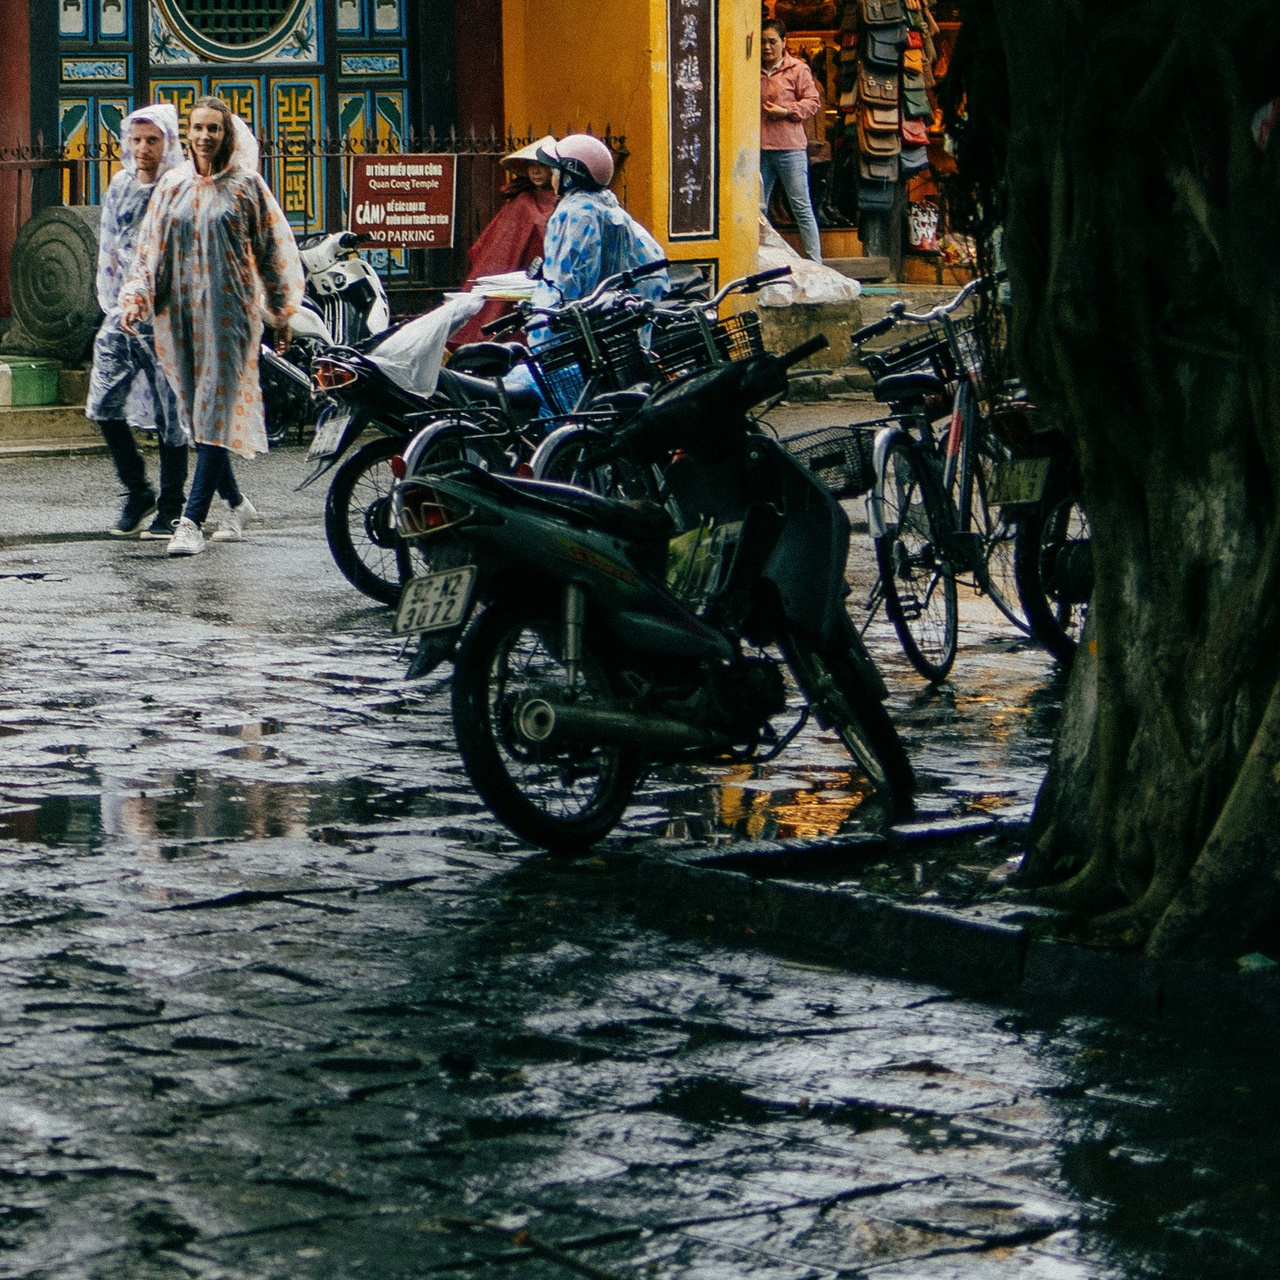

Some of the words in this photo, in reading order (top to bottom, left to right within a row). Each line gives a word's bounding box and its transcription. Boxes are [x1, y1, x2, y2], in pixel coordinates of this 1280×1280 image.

[369, 179, 390, 190] Quan
[390, 179, 411, 191] Cong
[411, 179, 439, 190] Temple
[369, 230, 387, 242] NO
[387, 230, 435, 242] PARKING
